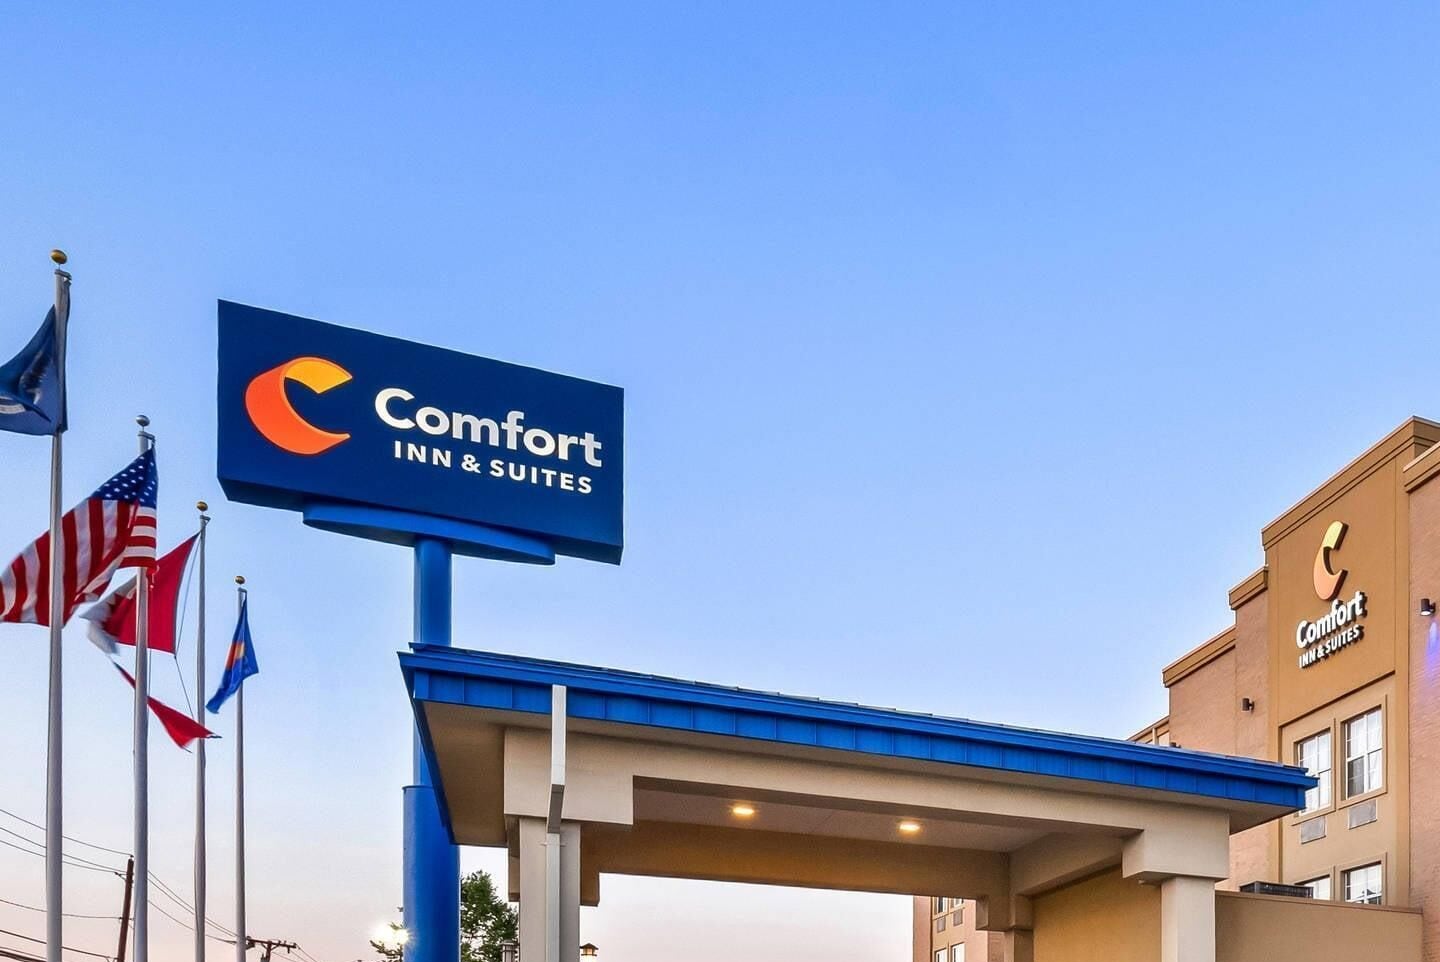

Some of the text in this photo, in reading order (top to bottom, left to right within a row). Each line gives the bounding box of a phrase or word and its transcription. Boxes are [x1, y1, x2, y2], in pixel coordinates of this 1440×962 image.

[375, 388, 602, 468] Comfort
[395, 440, 593, 494] INN & SUITES
[1296, 590, 1363, 649] Comfort
[1299, 624, 1360, 668] INN & SUITES
